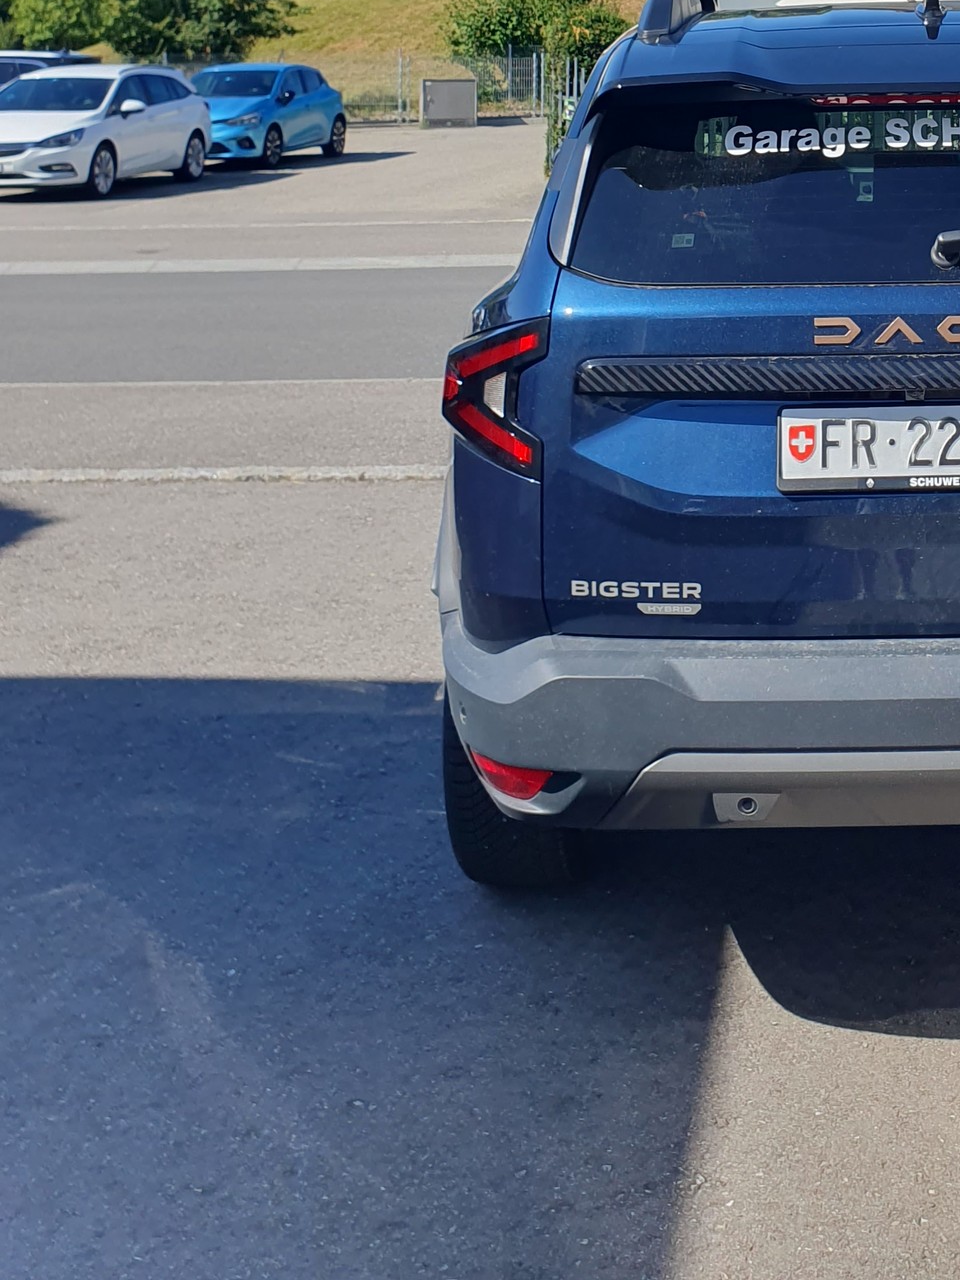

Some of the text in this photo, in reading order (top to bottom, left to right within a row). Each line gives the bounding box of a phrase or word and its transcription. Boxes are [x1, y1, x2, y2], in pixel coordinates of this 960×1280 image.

[724, 125, 872, 158] Garage
[570, 579, 702, 599] BIGSTER
[647, 605, 693, 614] HYBRID
